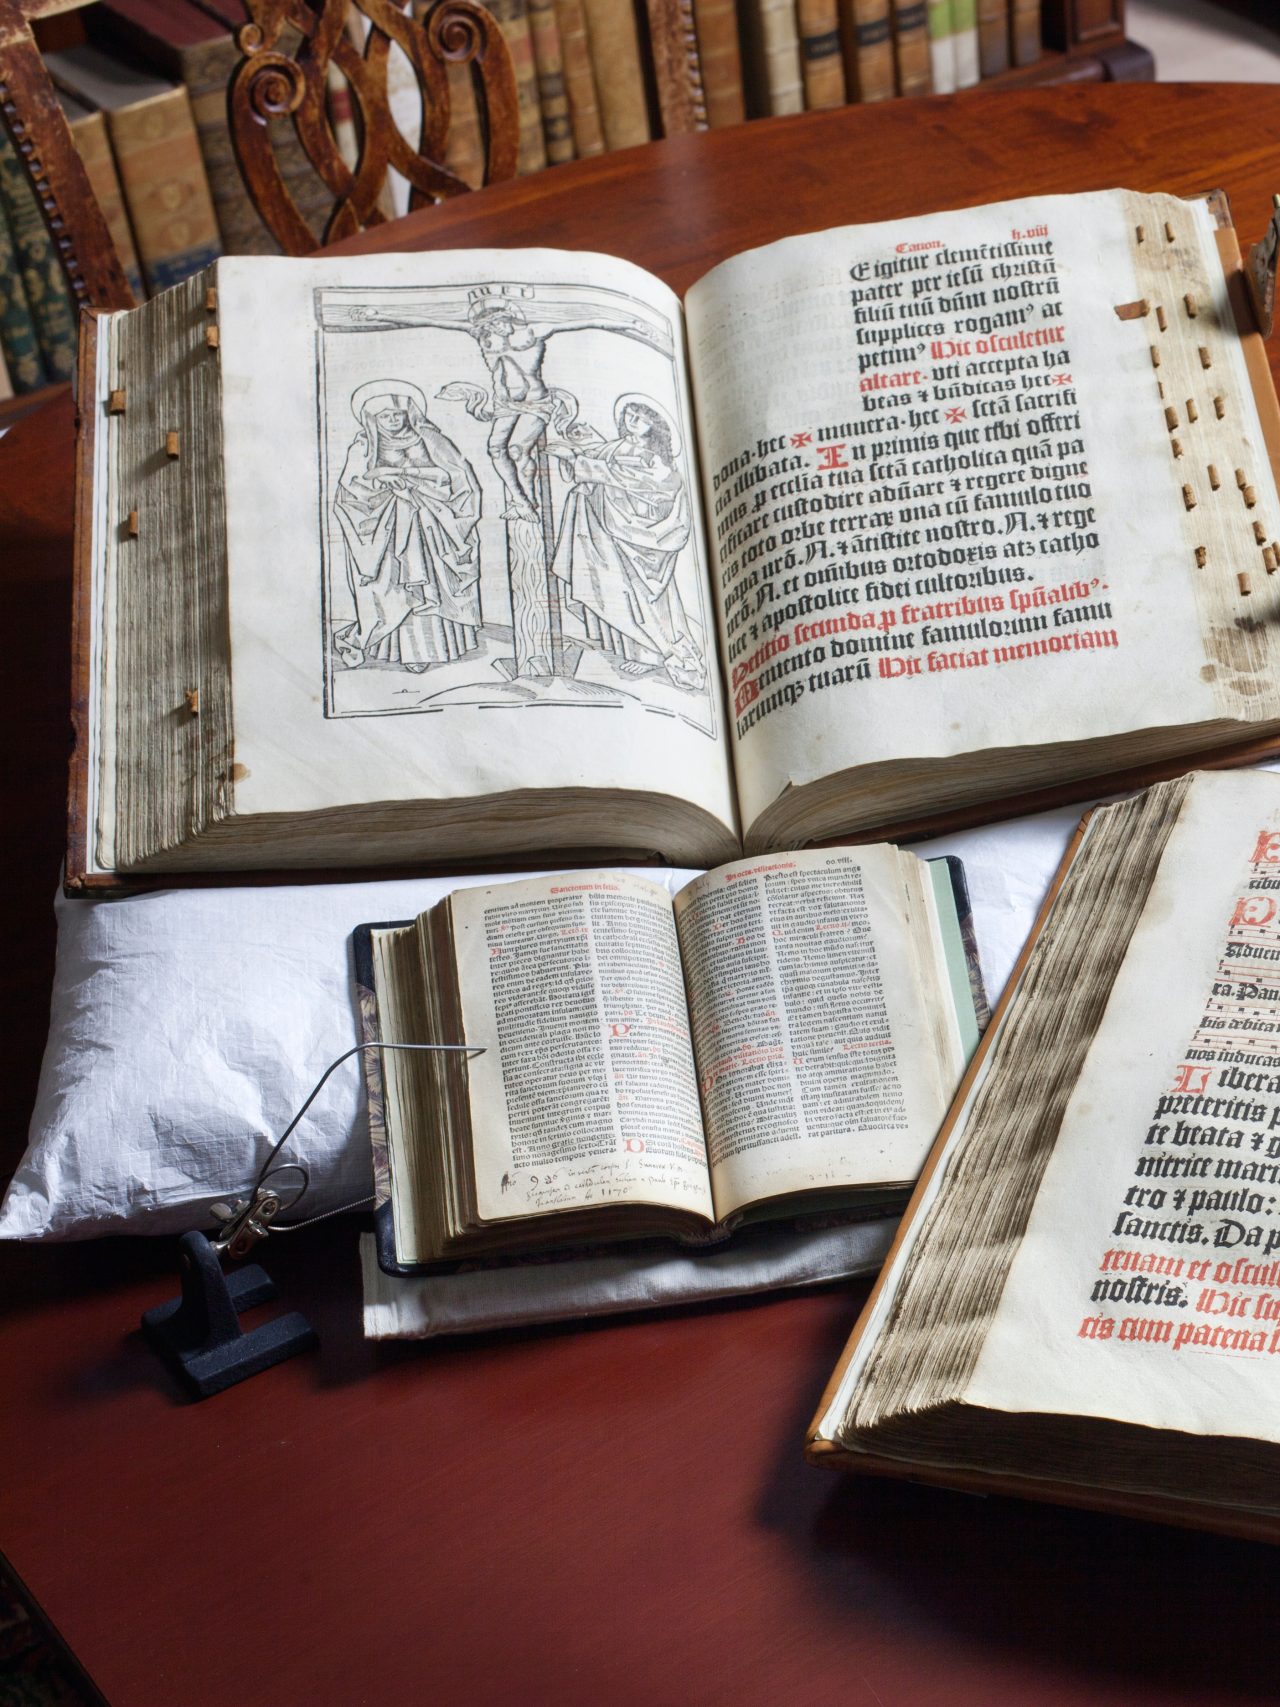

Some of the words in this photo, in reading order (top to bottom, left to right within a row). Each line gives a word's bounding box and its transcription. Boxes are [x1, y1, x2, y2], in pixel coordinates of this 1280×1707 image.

[851, 283, 903, 306] pater
[911, 275, 943, 298] per
[1042, 301, 1063, 318] ac
[829, 469, 863, 487] tua
[912, 448, 1007, 475] catholica
[966, 470, 1025, 491] regere
[1053, 507, 1096, 529] rege
[783, 576, 799, 595] et
[831, 632, 915, 659] domine
[927, 647, 988, 672] faciat
[993, 628, 1119, 663] memoriam
[1172, 1120, 1245, 1149] beata
[1123, 1184, 1166, 1210] tro
[1213, 1218, 1265, 1248] Da
[1187, 1259, 1212, 1281] et
[1173, 1320, 1269, 1351] patena
